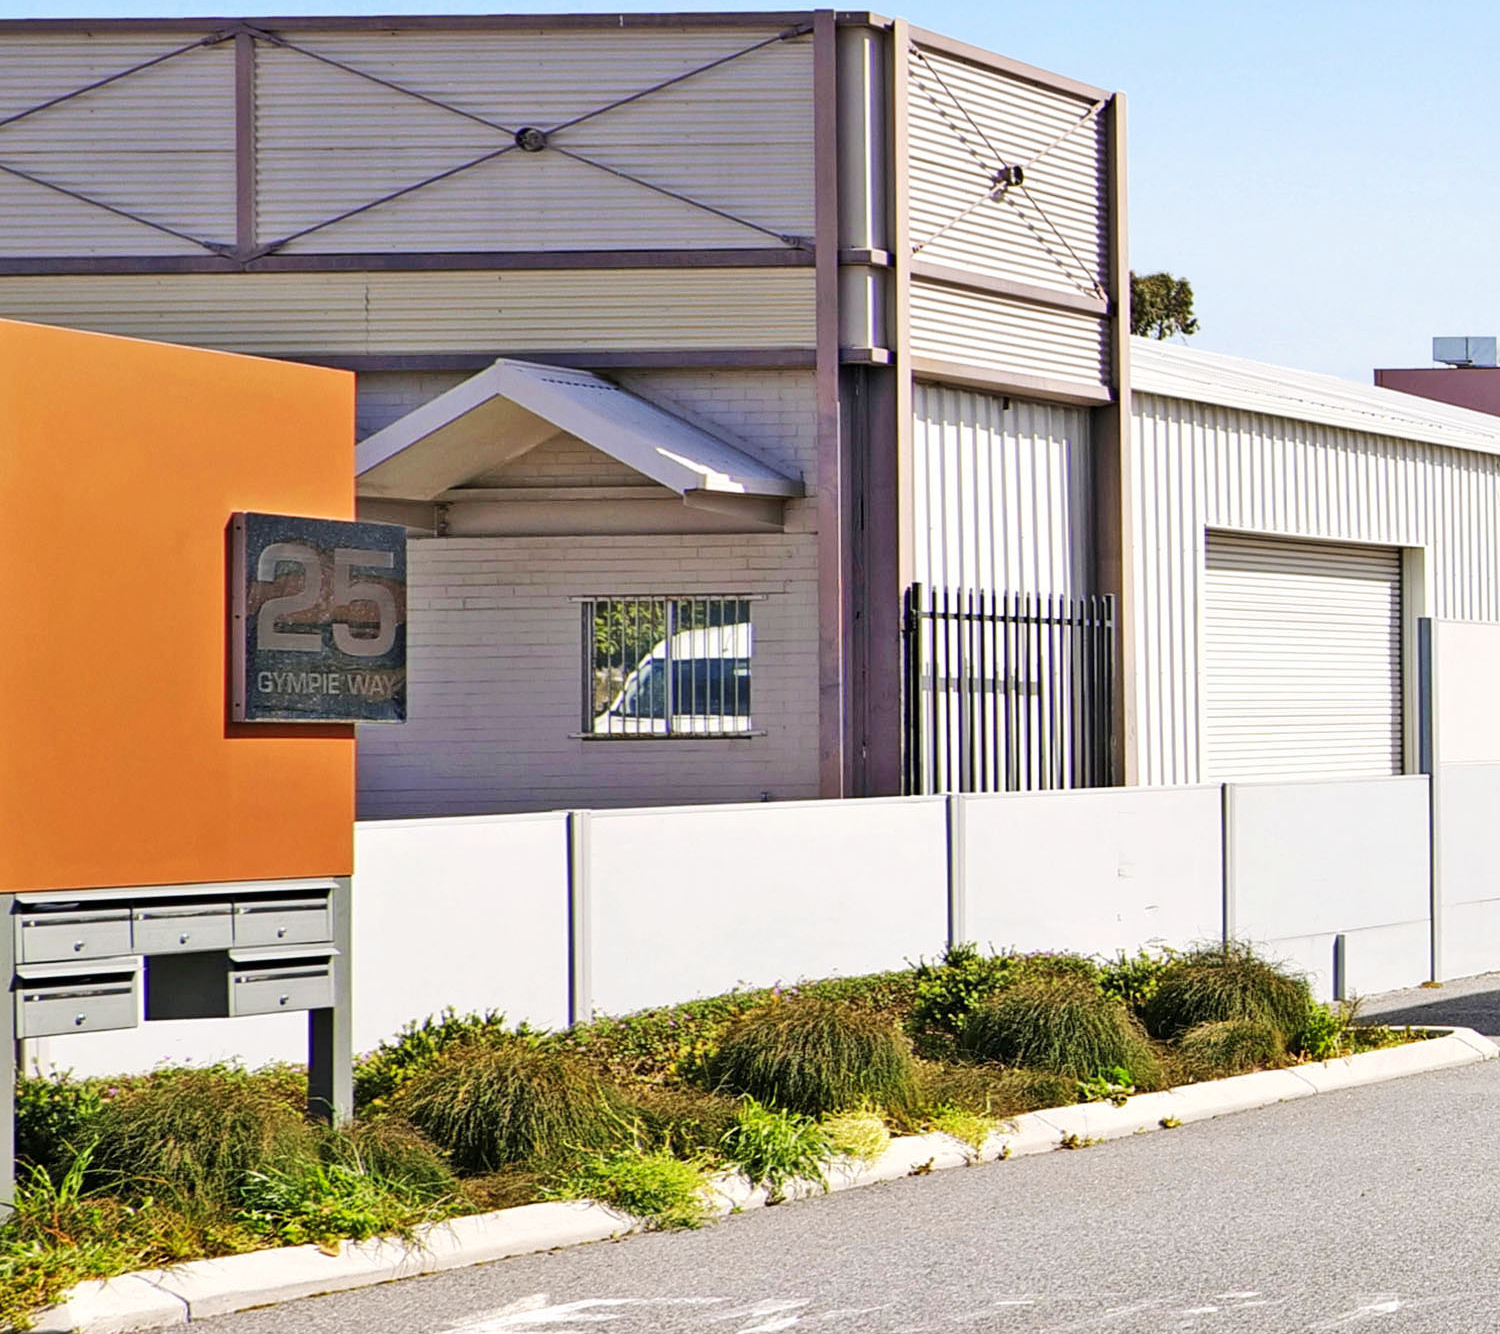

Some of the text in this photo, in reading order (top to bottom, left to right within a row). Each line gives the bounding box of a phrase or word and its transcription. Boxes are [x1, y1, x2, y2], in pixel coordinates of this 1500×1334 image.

[257, 543, 397, 656] 25
[258, 670, 395, 697] GYMPIE WAY
